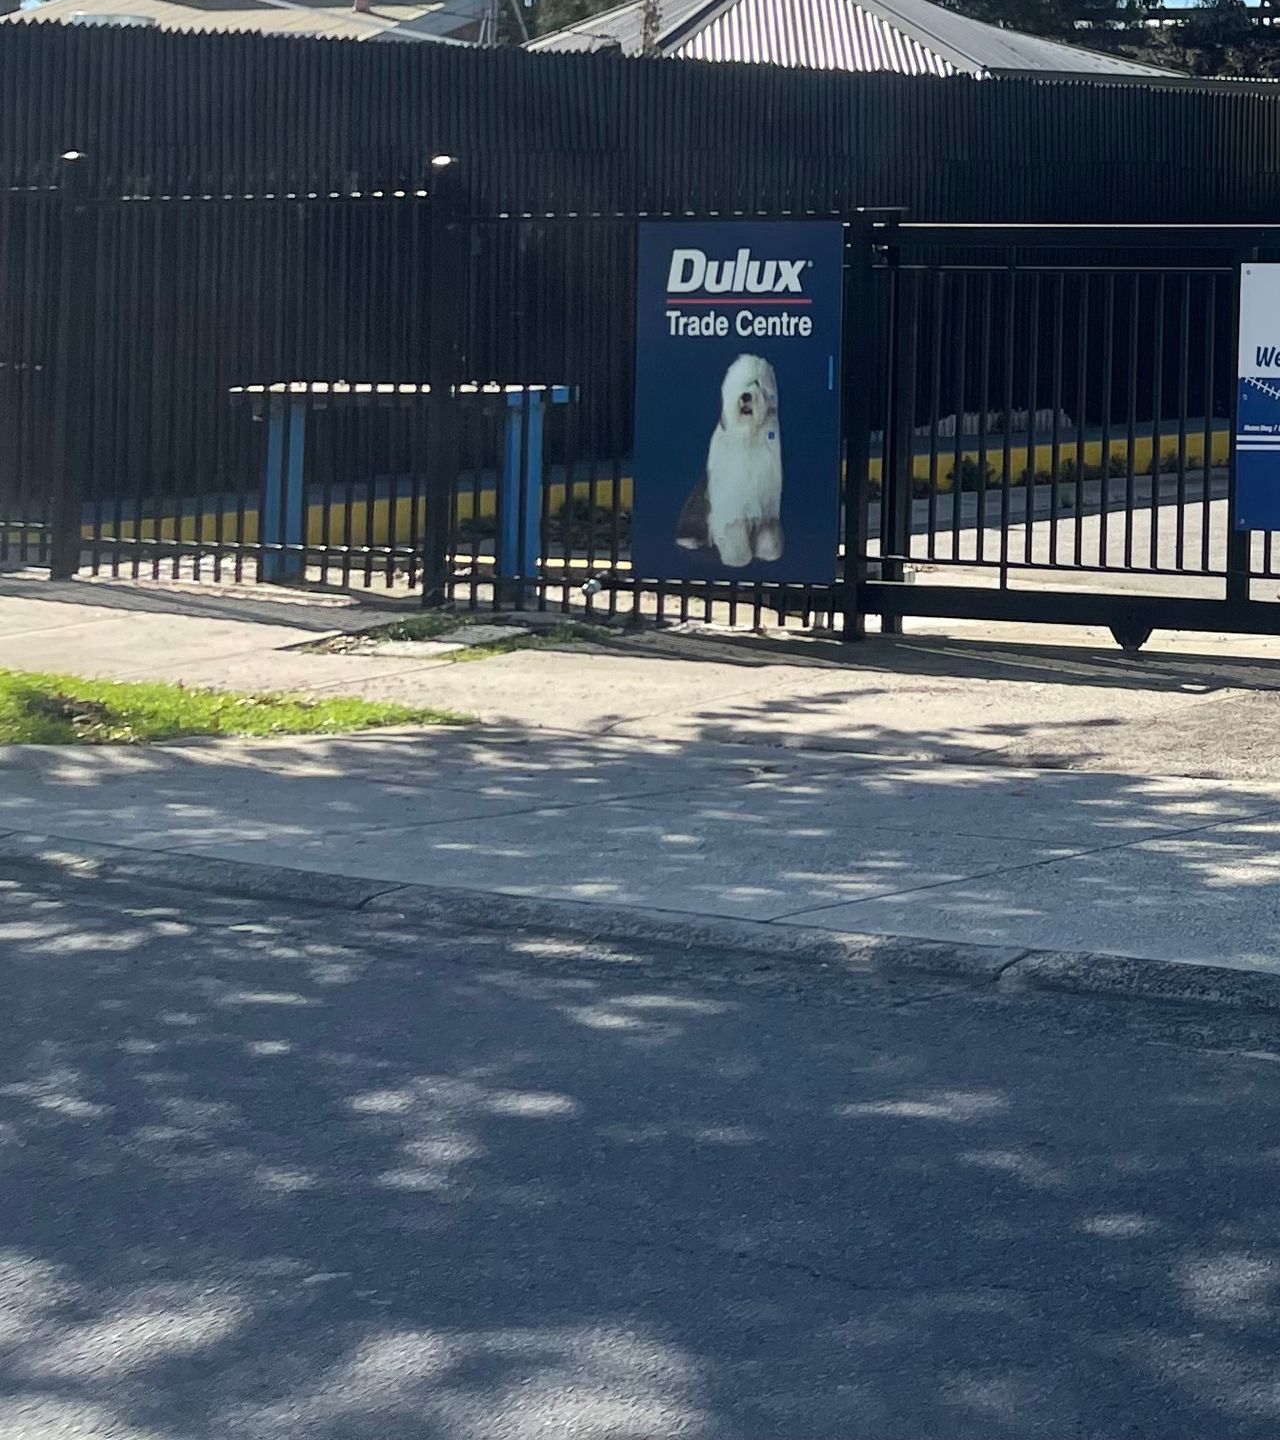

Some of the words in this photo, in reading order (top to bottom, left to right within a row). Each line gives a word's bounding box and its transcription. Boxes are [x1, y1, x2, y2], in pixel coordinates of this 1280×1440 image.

[667, 248, 806, 293] Dulux
[666, 310, 729, 336] Trade
[736, 310, 813, 337] Centre
